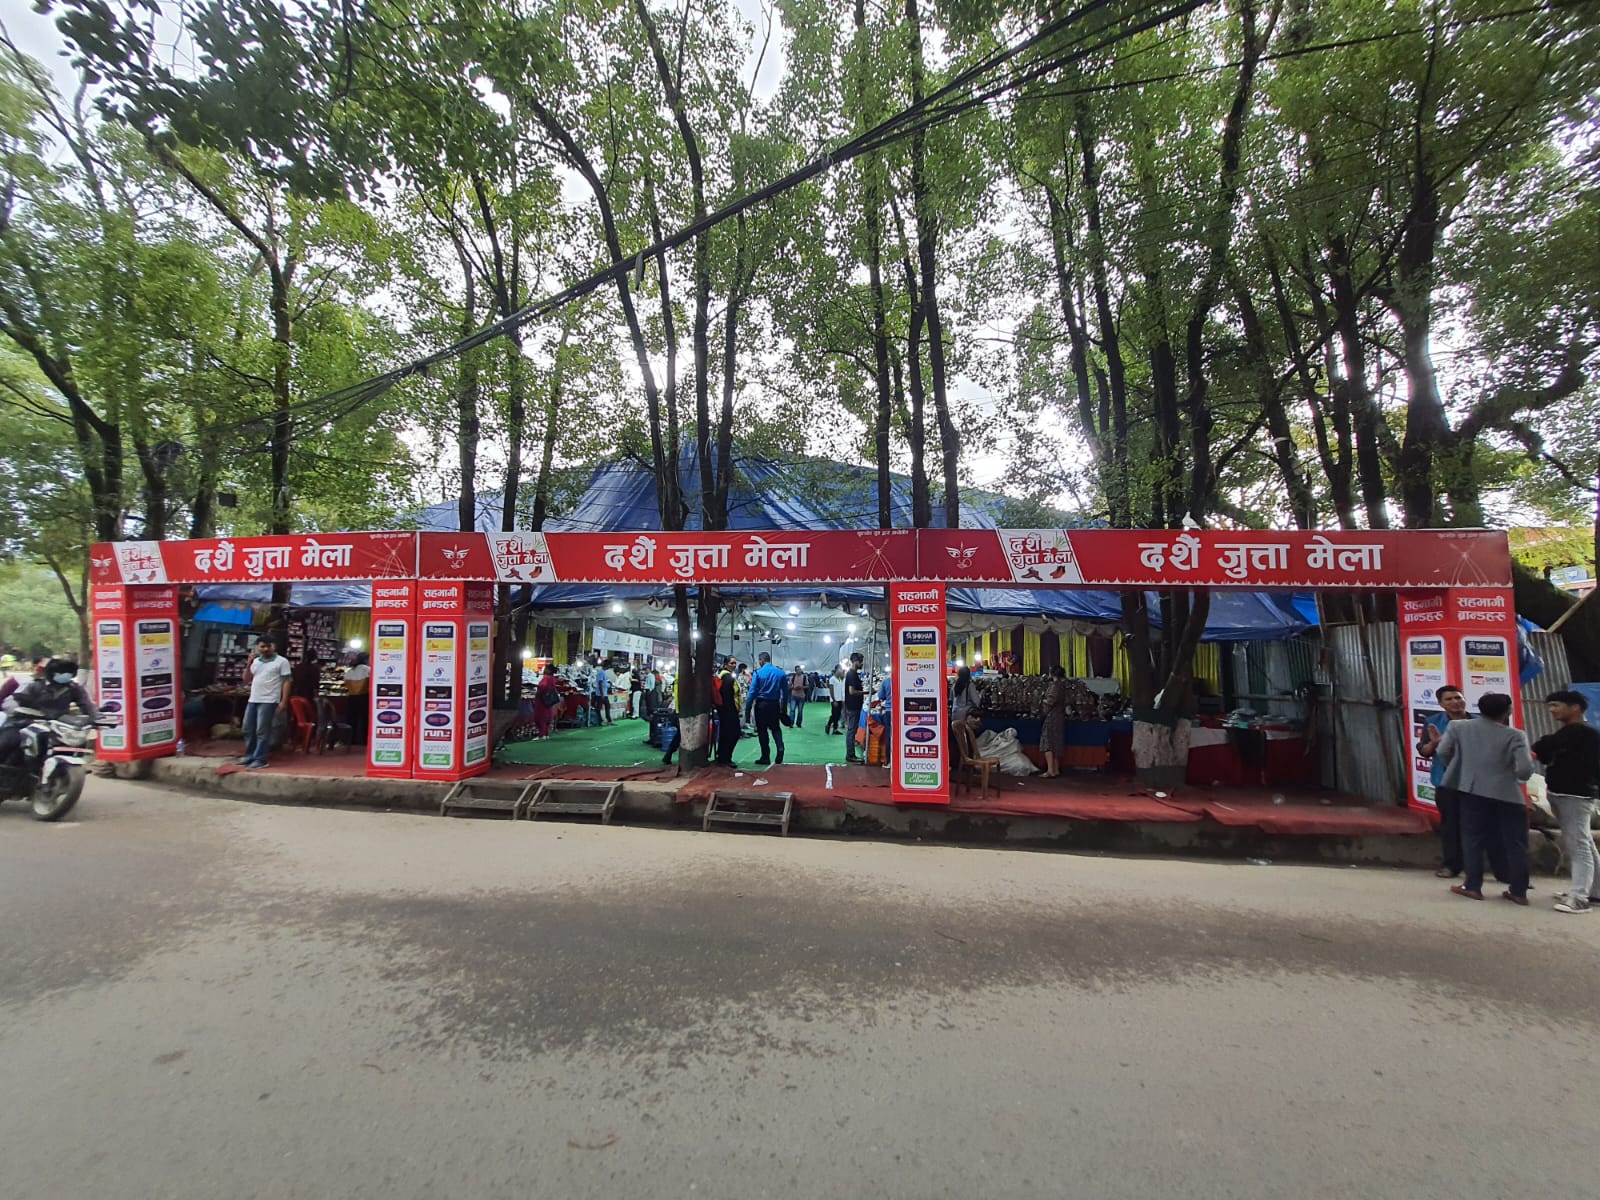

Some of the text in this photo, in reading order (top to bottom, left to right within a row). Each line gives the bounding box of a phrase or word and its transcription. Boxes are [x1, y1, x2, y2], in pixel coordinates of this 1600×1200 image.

[194, 538, 353, 577] दशैं जुत्ता मेला
[496, 549, 549, 569] जुत्ता मेला
[603, 535, 811, 577] दशैं जुत्ता मेला
[1010, 547, 1072, 569] जुत्ता मेला
[1138, 533, 1384, 579] दशैं जुत्ता मेला
[423, 587, 457, 598] सहभागी
[897, 588, 939, 601] सहभागी
[1457, 595, 1505, 608] सहभागी
[424, 730, 442, 738] run
[905, 746, 929, 754] run
